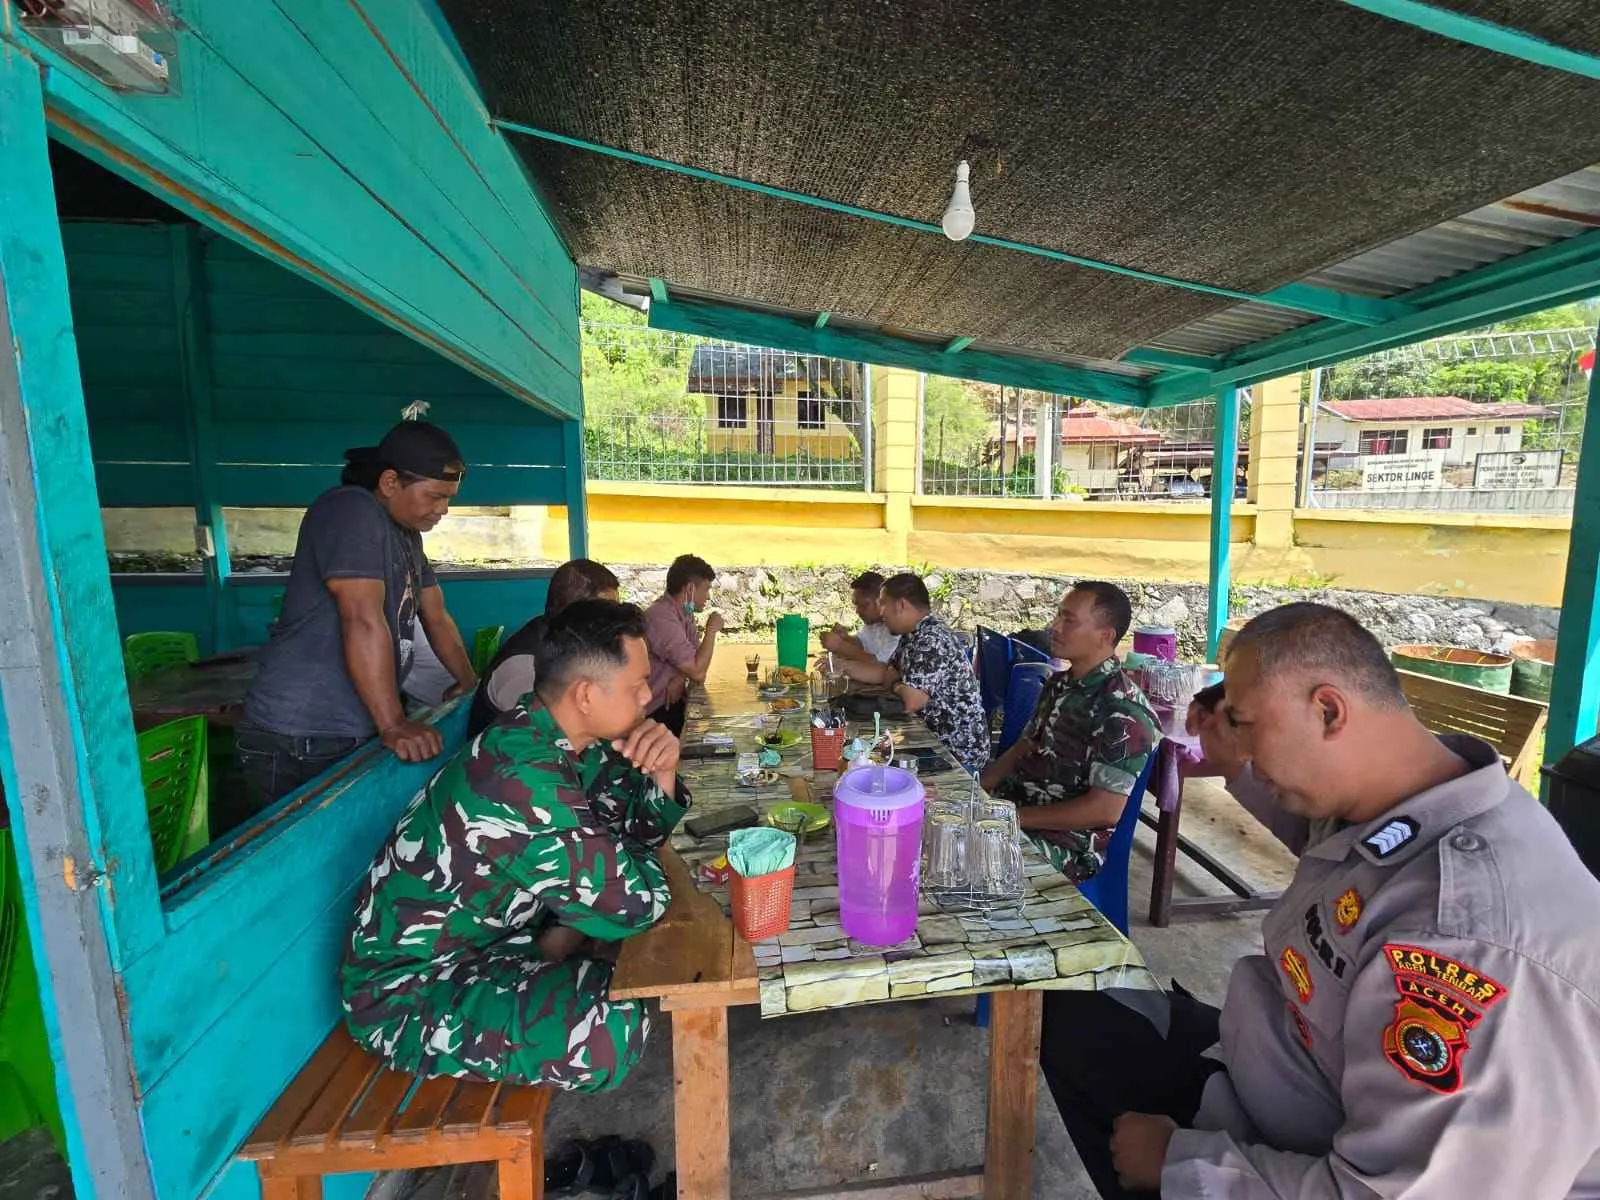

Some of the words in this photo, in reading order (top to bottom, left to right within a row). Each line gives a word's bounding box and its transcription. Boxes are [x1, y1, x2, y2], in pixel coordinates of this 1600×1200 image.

[1367, 472, 1403, 483] SEKTOR
[1406, 471, 1435, 481] LINGE
[1391, 949, 1497, 998] POLRES
[1398, 962, 1427, 974] ACEH
[1409, 981, 1466, 1016] ACEH
